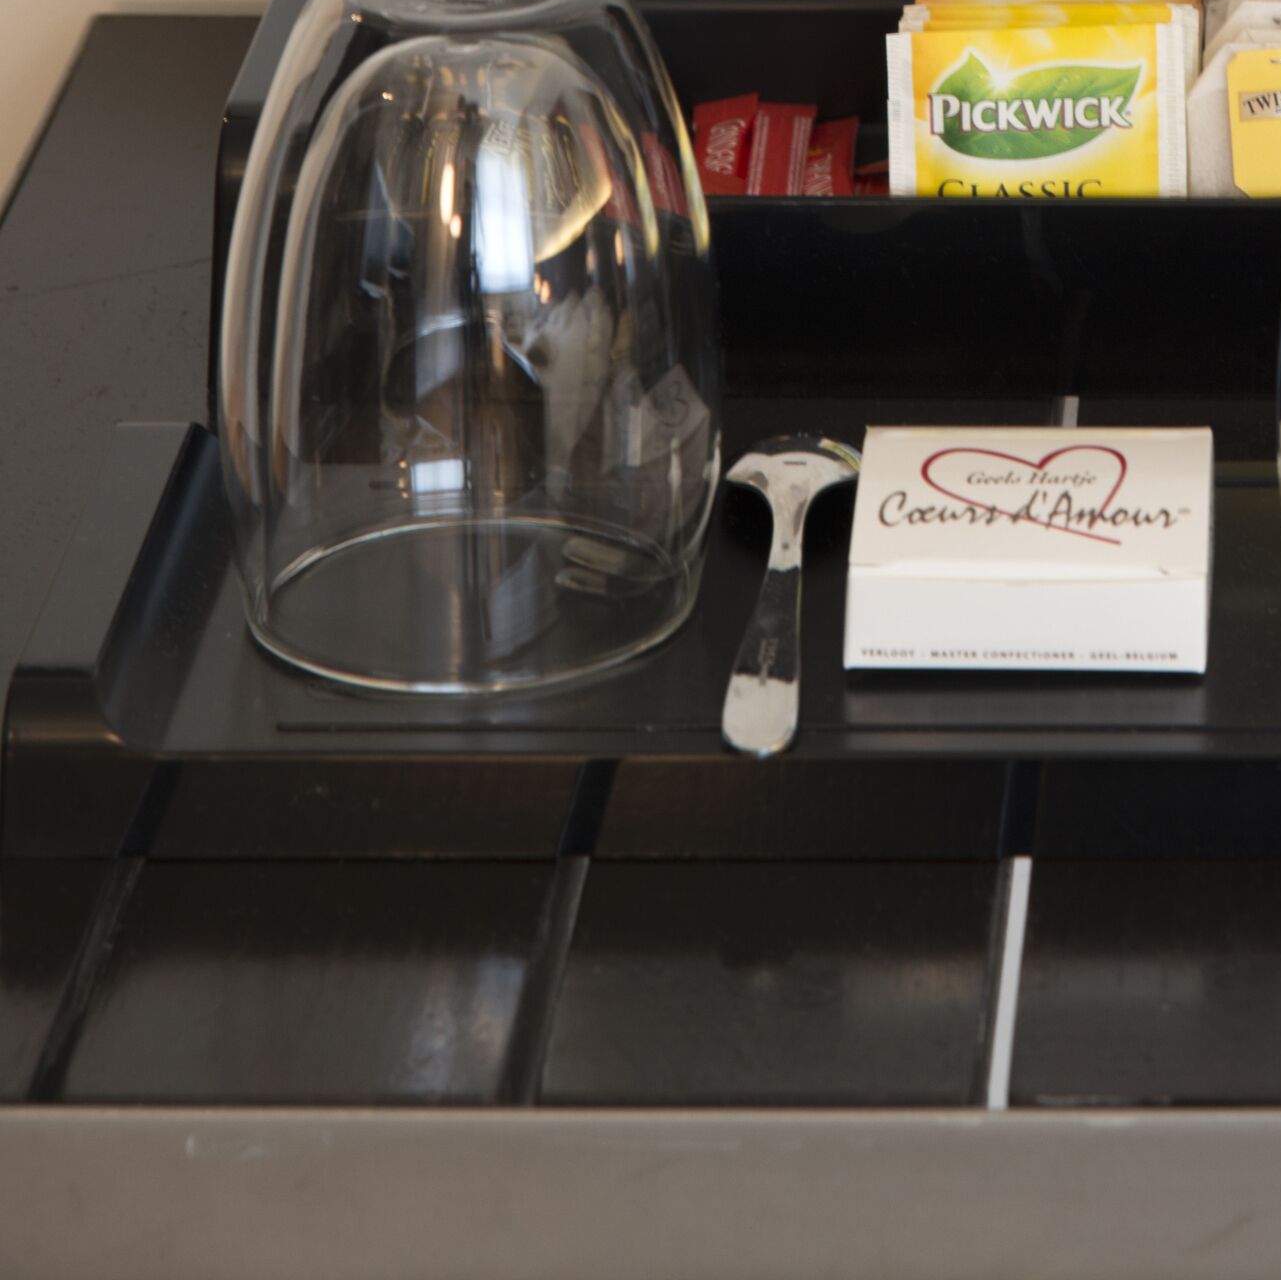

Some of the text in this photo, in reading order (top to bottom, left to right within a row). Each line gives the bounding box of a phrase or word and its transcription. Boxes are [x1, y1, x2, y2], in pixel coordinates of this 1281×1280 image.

[929, 93, 1133, 136] PICKWICK
[1027, 470, 1098, 488] Hartje
[930, 650, 978, 659] MASTER
[983, 650, 1075, 660] CONFECTIONER
